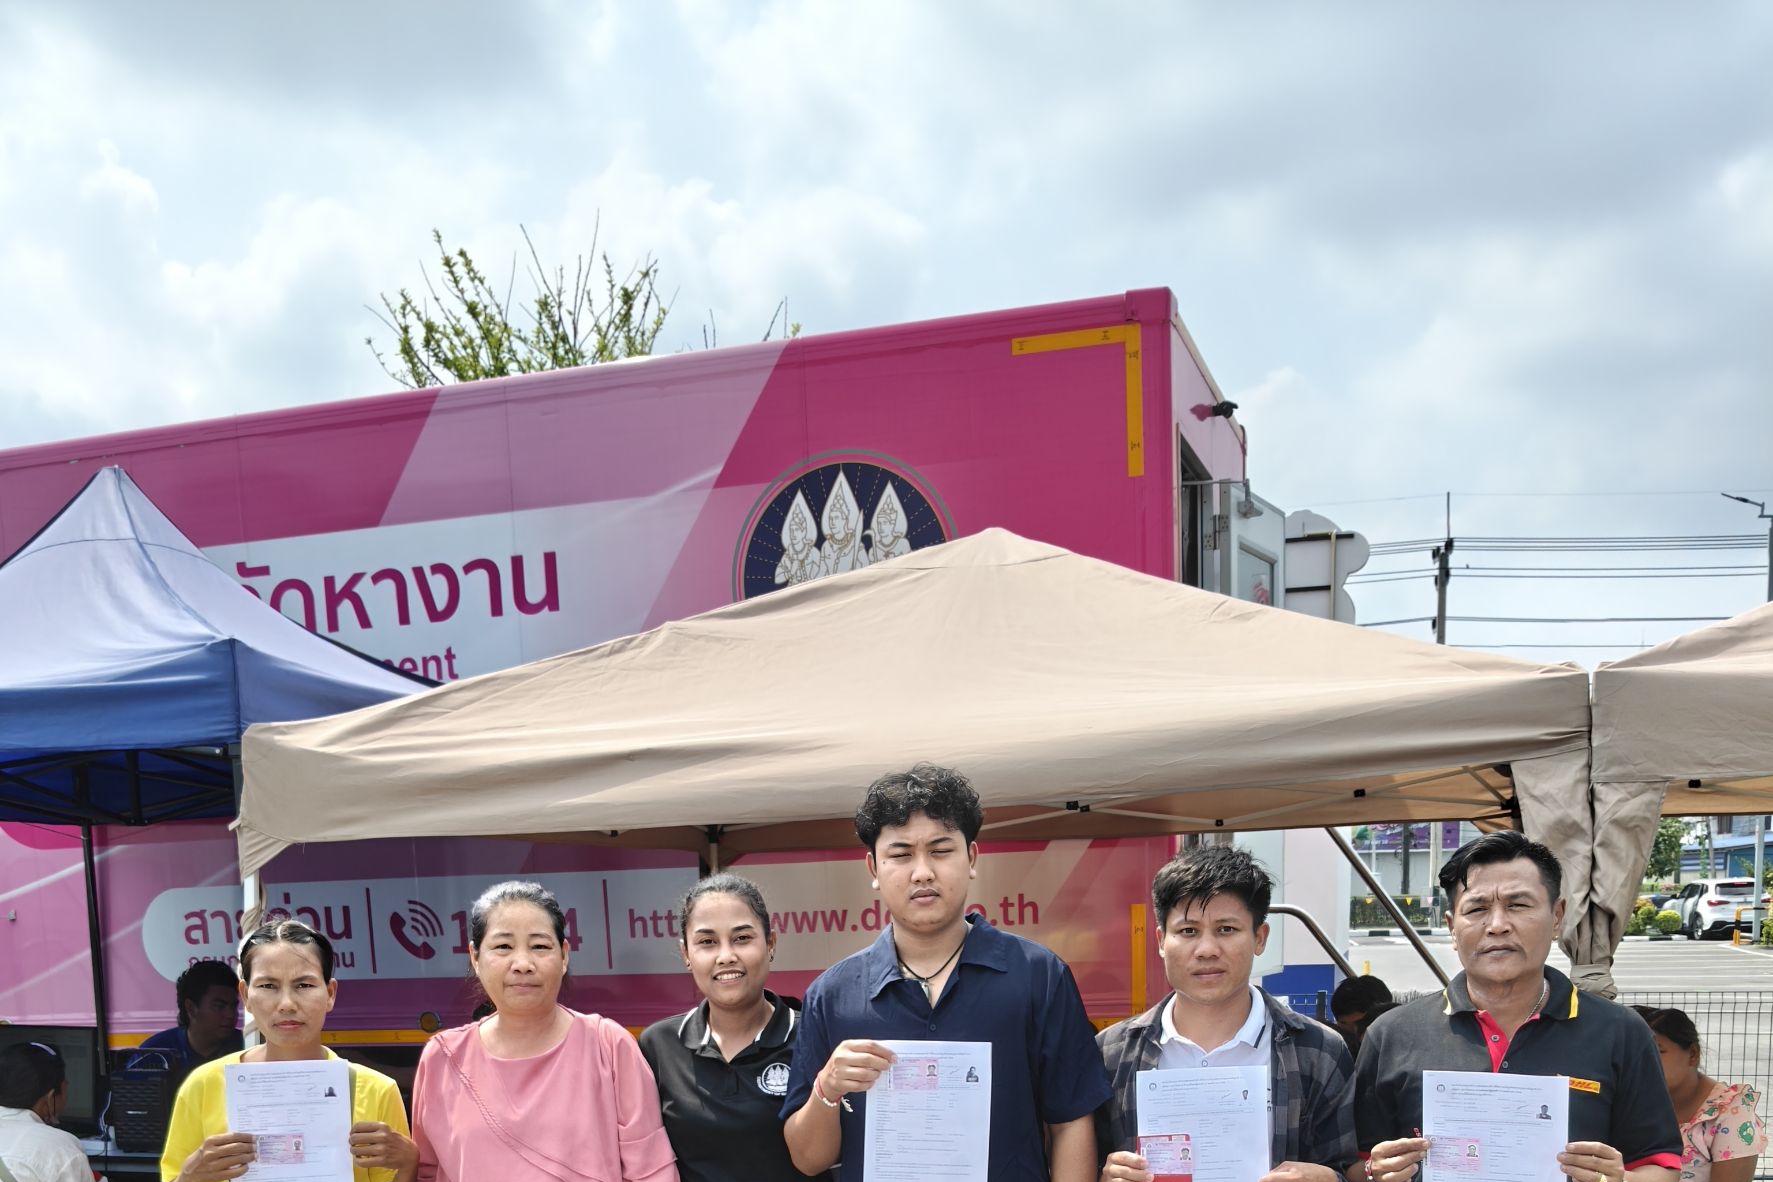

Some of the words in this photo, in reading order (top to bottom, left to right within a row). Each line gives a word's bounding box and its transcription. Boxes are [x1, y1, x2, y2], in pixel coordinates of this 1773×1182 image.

[236, 551, 560, 634] ัดหางาน
[184, 892, 353, 945] สา่วน
[451, 908, 583, 954] 14
